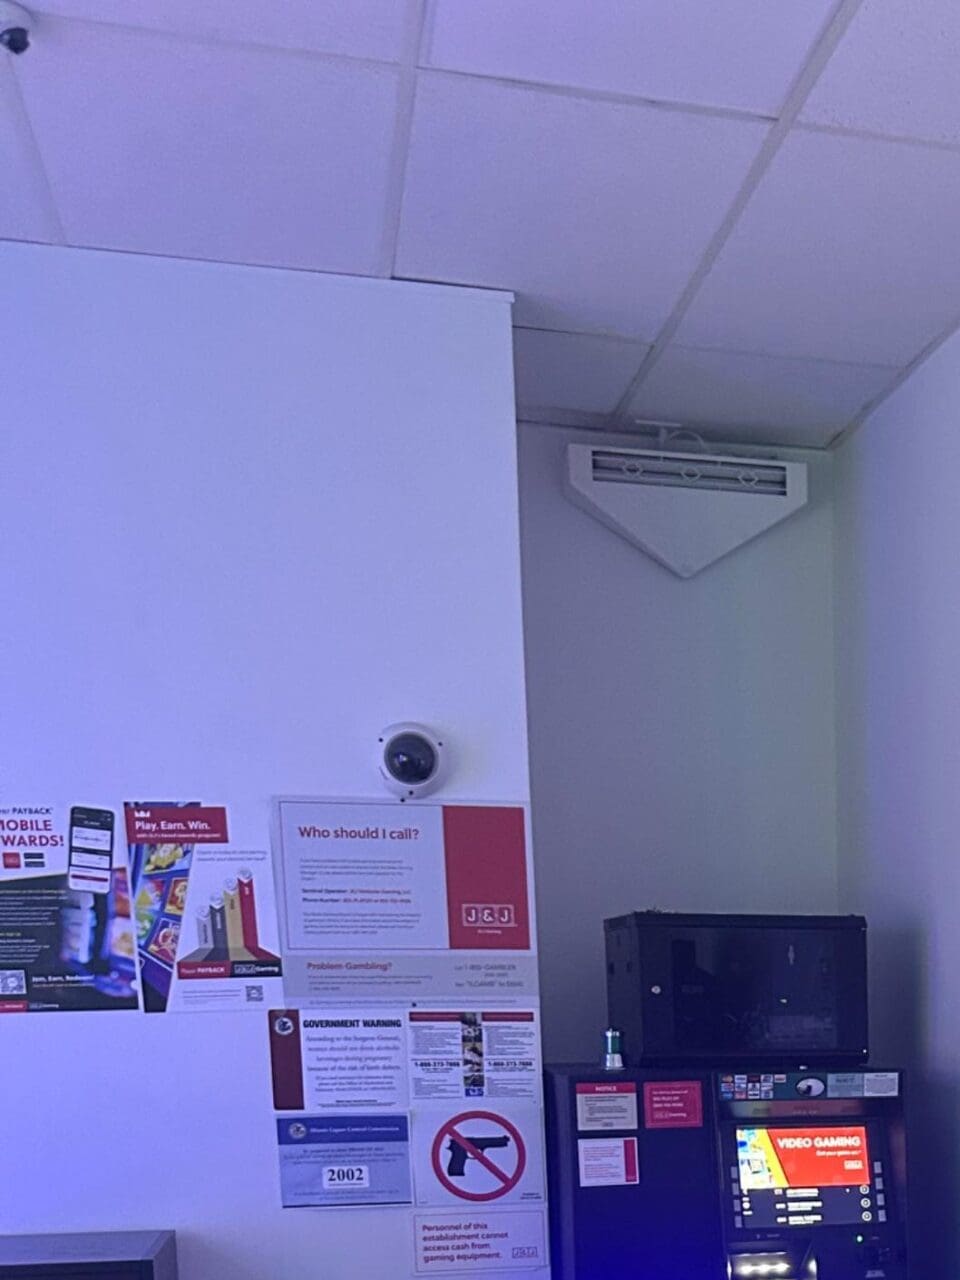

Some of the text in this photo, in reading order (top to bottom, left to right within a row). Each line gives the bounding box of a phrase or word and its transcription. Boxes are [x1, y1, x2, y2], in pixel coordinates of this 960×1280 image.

[135, 821, 211, 832] Play. Earn. Win.
[298, 826, 420, 840] Who should I call?
[303, 1019, 402, 1028] GOVERNMENT WARNING
[777, 1136, 861, 1149] VIDEO GAMING
[328, 1168, 364, 1181] 2002
[422, 1223, 462, 1231] Personnel
[473, 1222, 488, 1230] this
[422, 1232, 480, 1242] establishment
[423, 1244, 450, 1252] access
[423, 1254, 455, 1264] gaming
